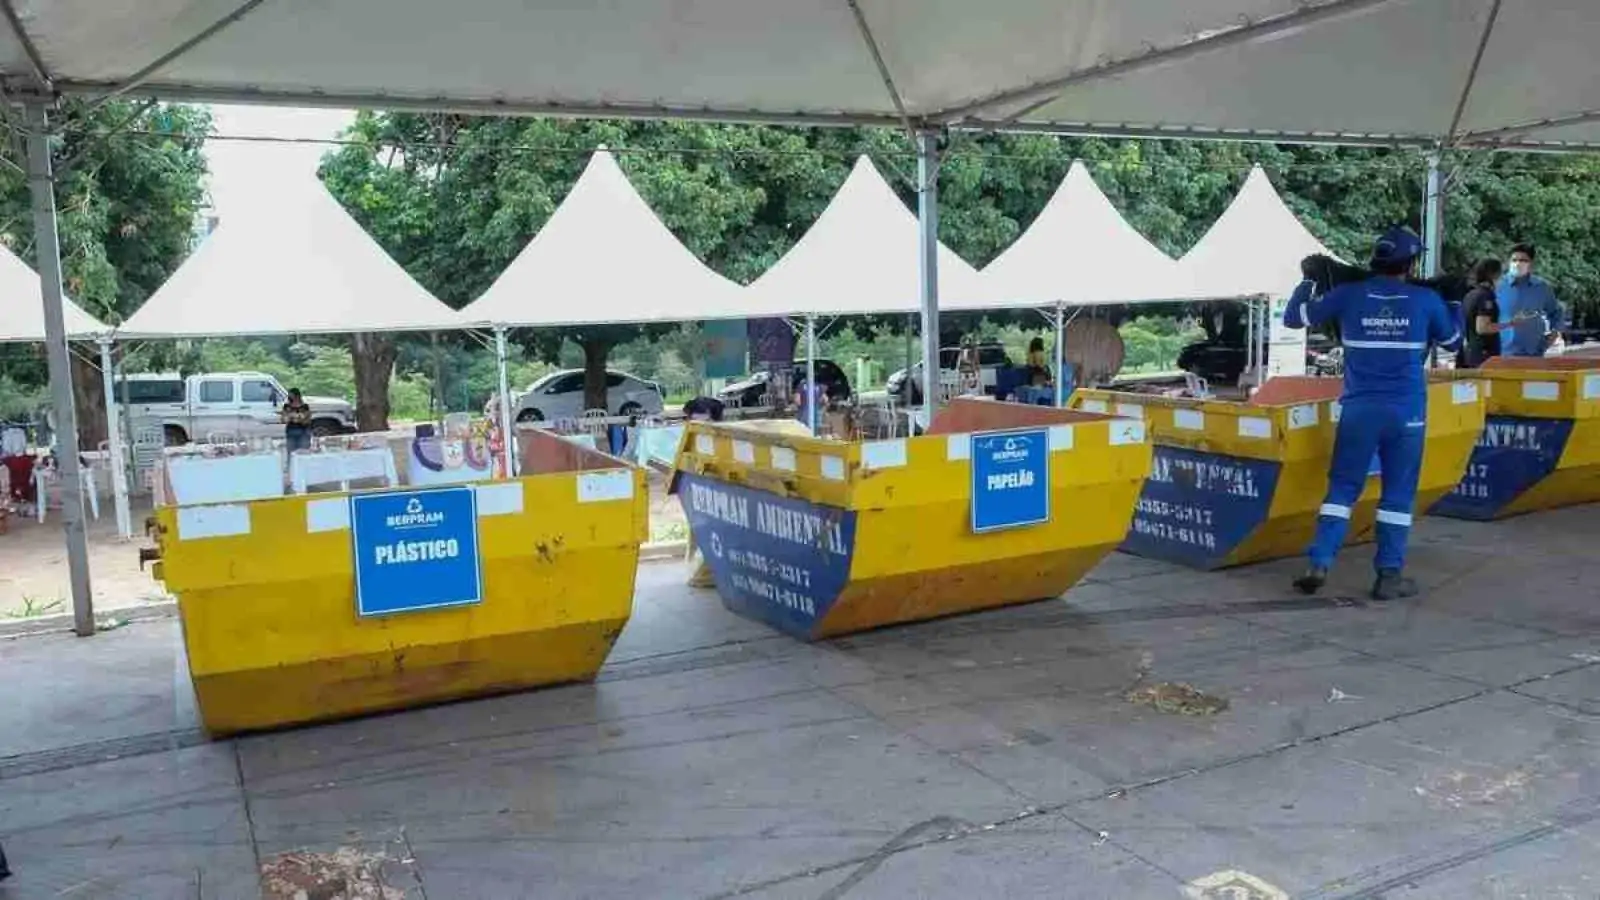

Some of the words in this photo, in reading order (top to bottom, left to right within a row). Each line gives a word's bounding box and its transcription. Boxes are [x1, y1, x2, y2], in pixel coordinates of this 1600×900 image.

[987, 469, 1034, 491] PAPELÃO
[690, 482, 749, 528] BERPRAM
[386, 512, 444, 526] BERPRAM
[375, 539, 459, 565] PLÁSTICO
